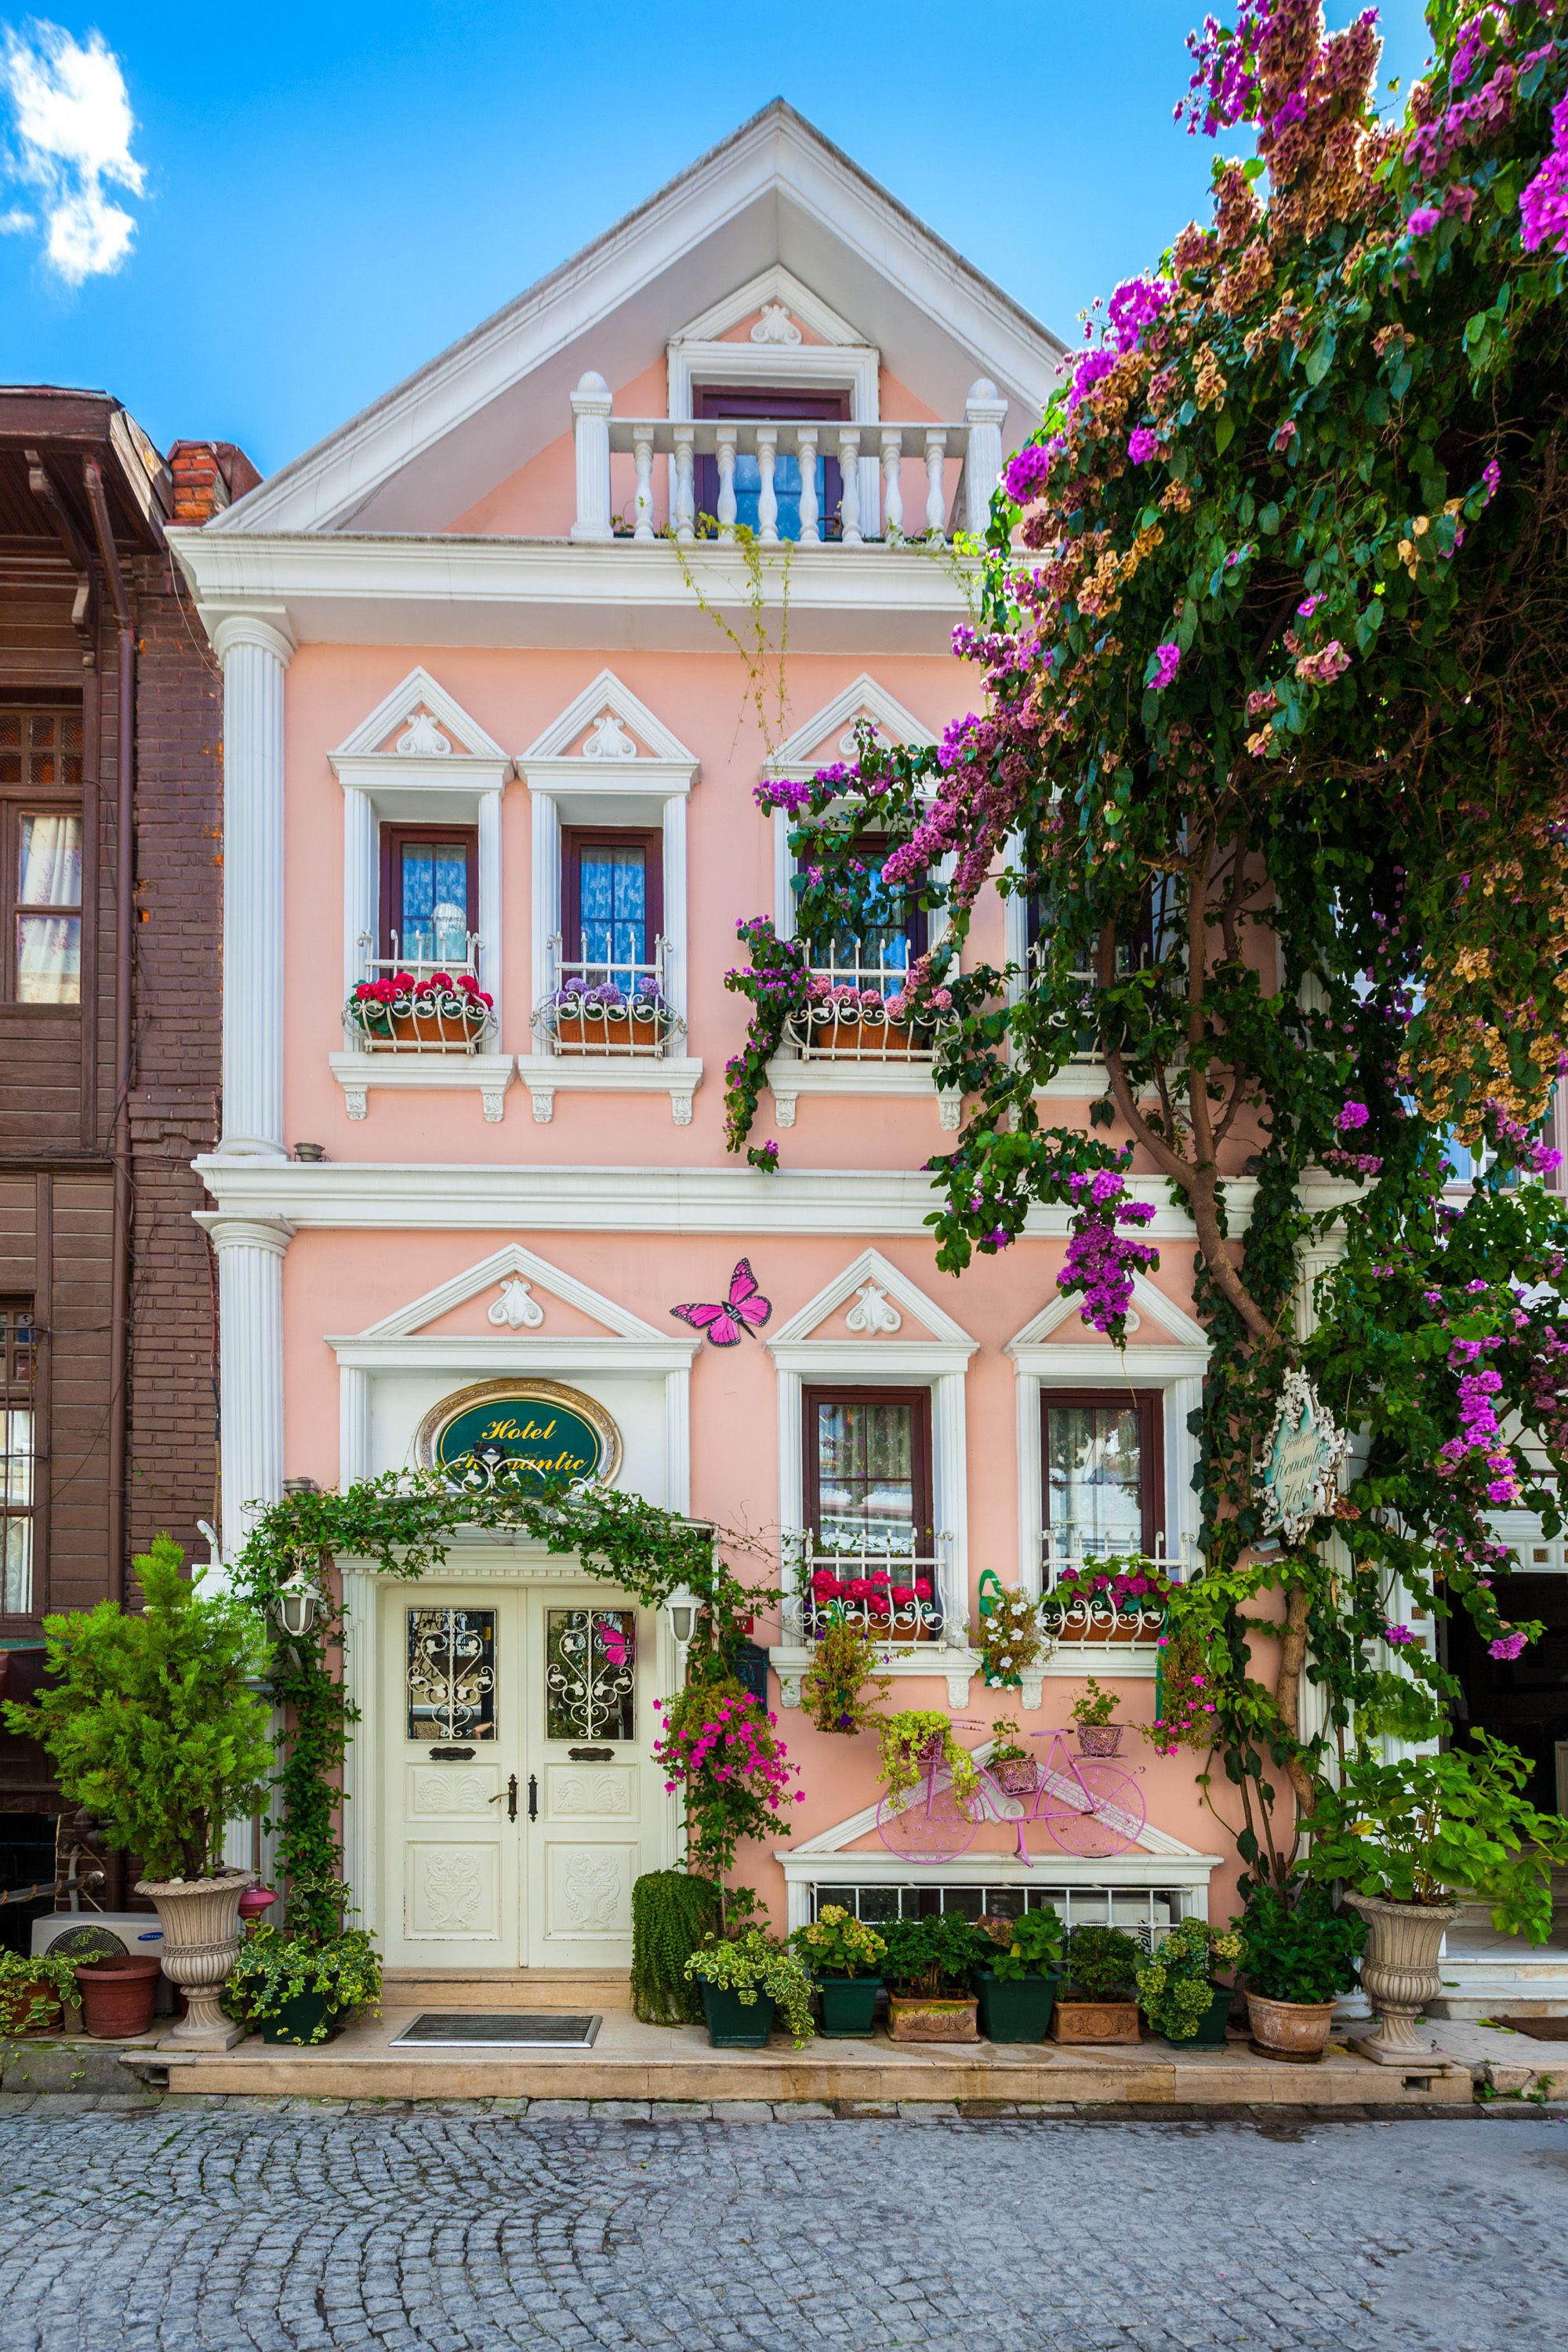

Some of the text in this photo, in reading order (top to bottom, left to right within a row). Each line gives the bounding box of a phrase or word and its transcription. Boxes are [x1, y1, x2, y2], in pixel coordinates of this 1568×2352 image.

[481, 1418, 557, 1440] Hotel
[455, 1449, 588, 1471] Rantic
[1273, 1444, 1323, 1483] Romantic
[1282, 1466, 1315, 1508] Hotel
